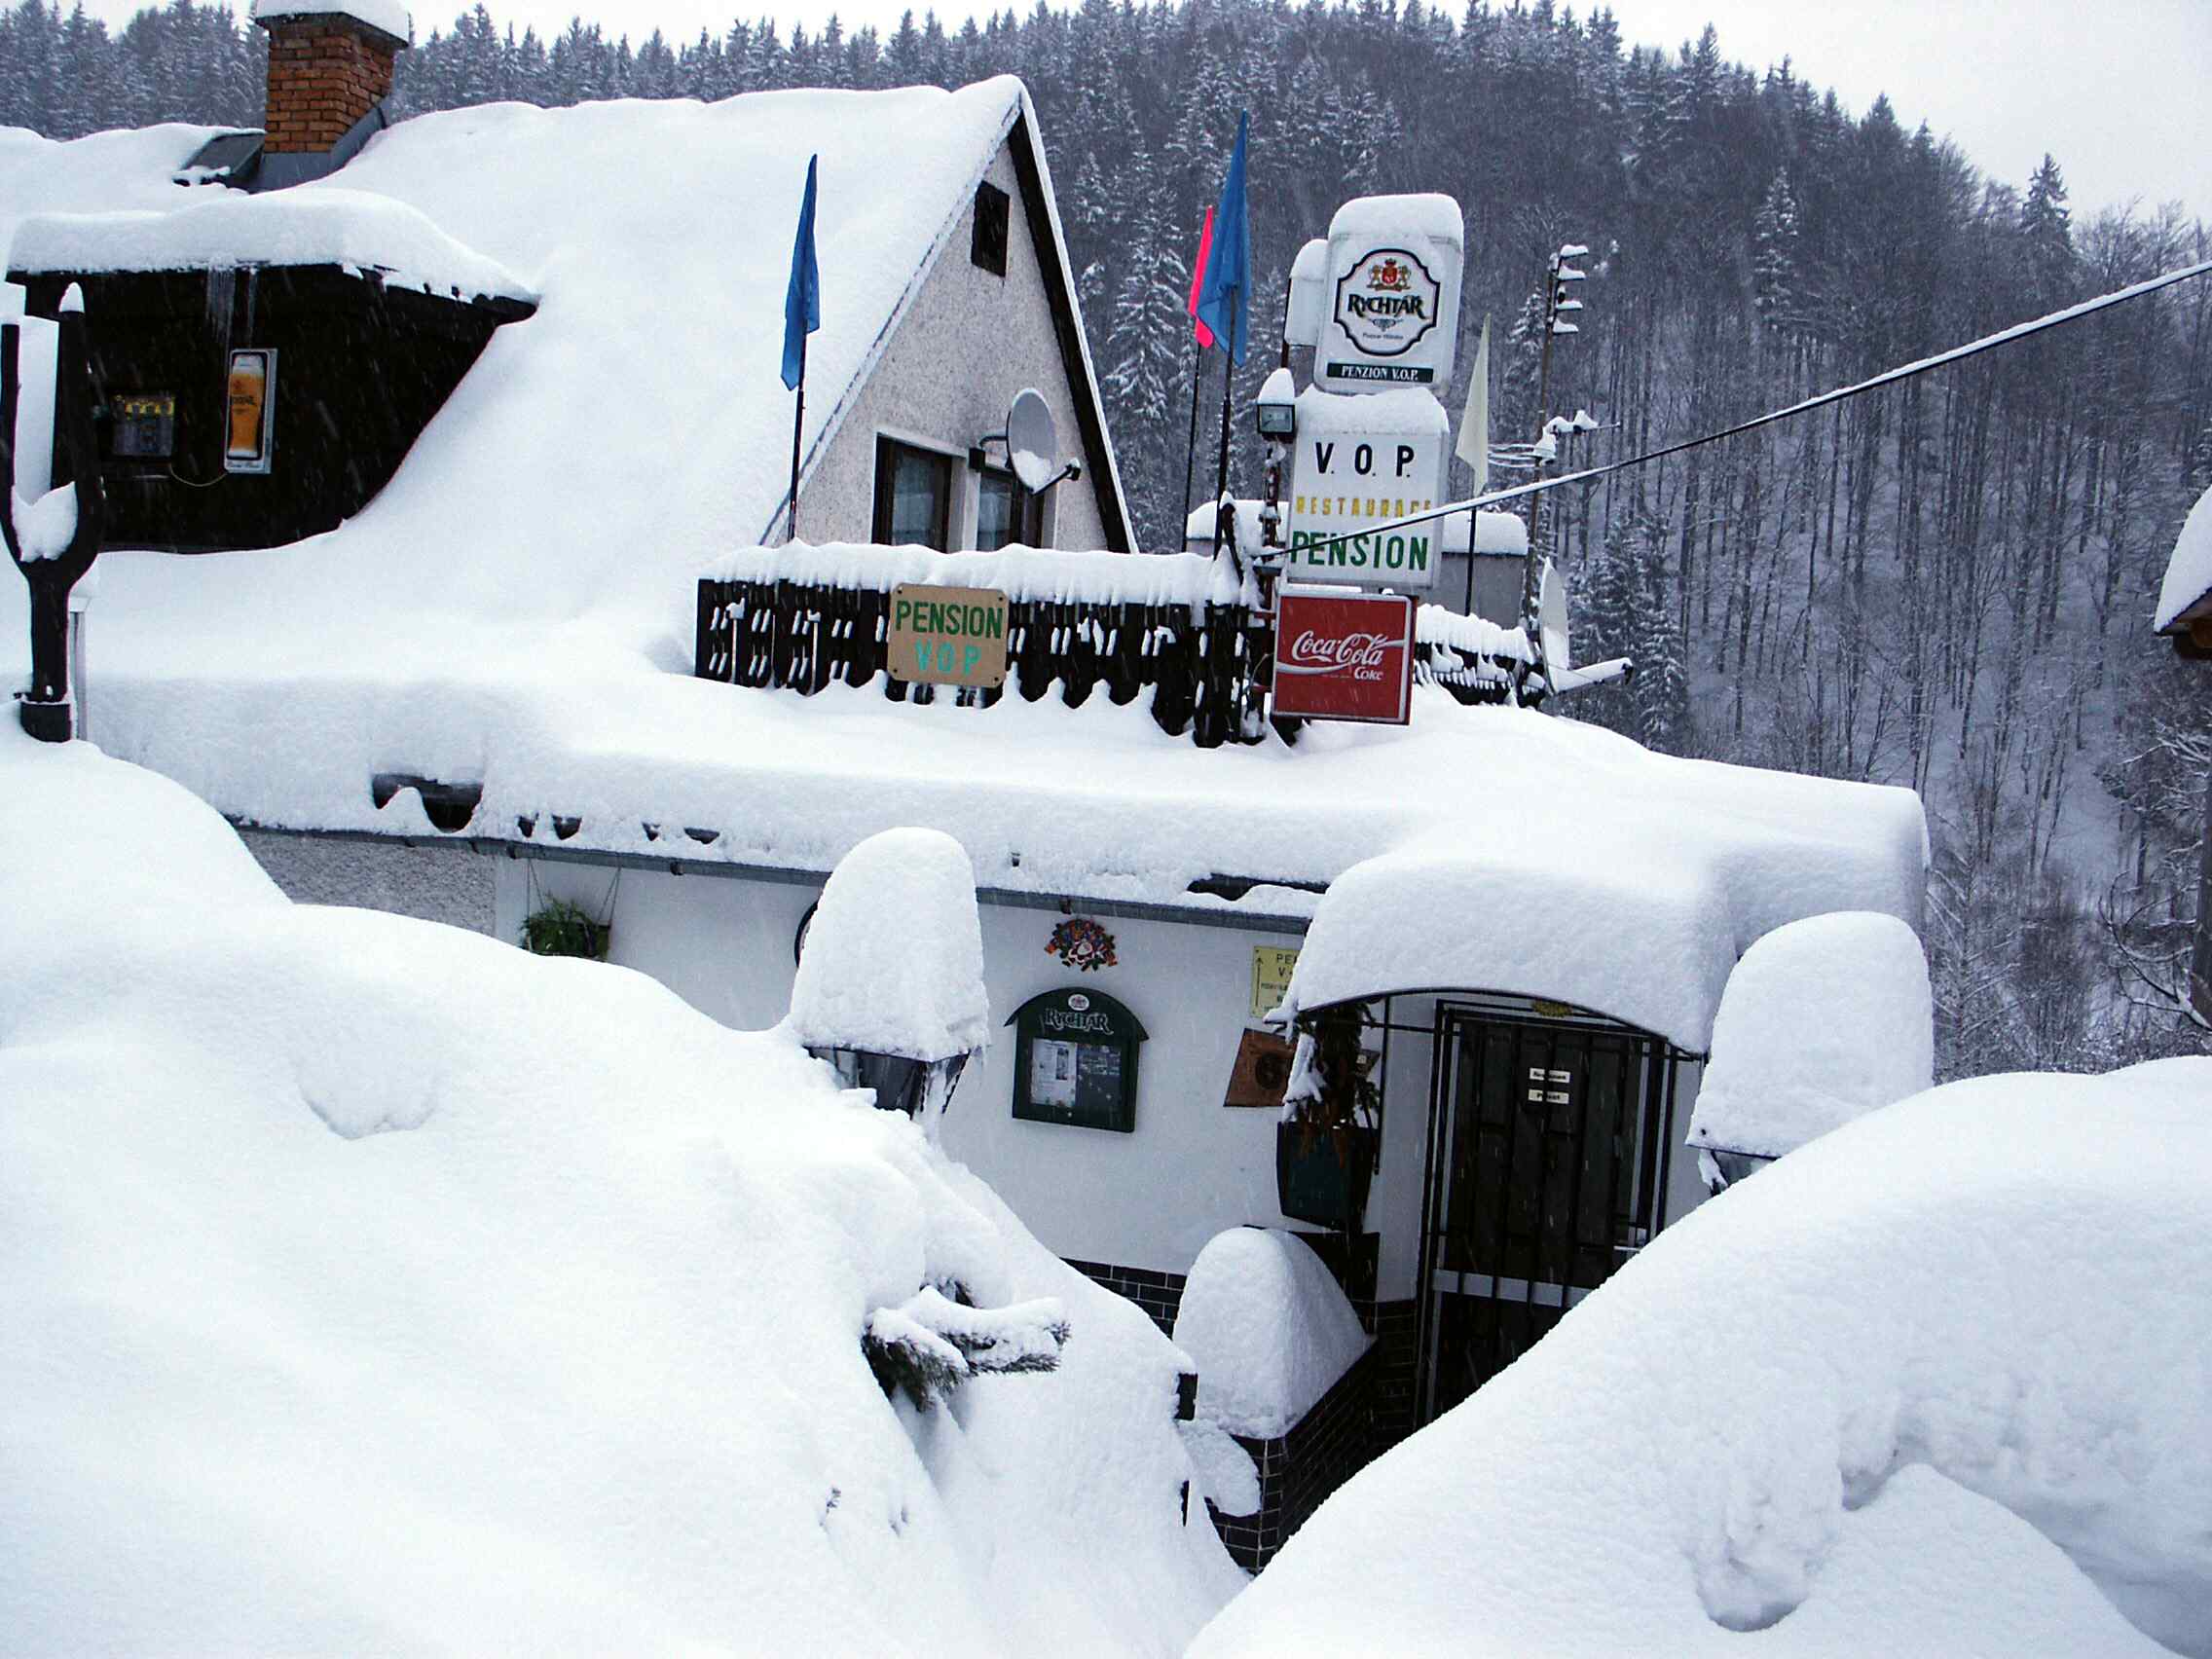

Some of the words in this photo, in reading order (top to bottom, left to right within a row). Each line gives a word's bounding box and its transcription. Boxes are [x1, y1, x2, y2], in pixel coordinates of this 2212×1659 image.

[1342, 365, 1387, 379] PENZION
[1290, 531, 1428, 571] PENSION
[895, 600, 1003, 639] PENSION
[1354, 666, 1383, 681] Coke
